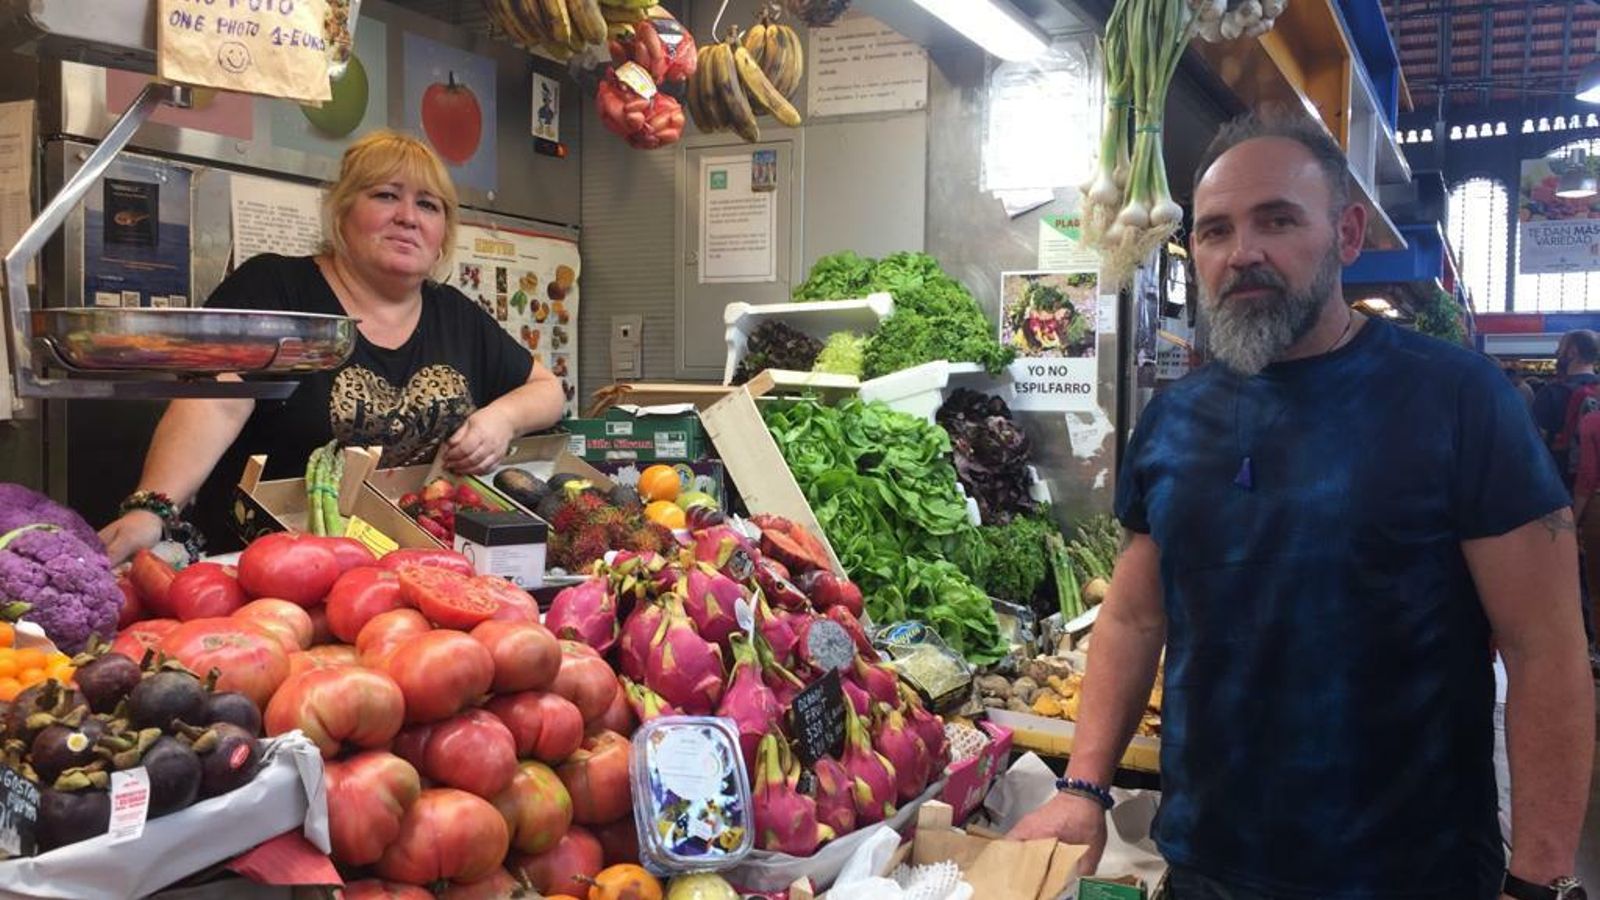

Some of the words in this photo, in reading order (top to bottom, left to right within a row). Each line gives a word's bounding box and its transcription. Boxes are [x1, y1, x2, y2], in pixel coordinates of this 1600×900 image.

[169, 10, 205, 32] ONE
[217, 18, 260, 37] PHOTO
[1528, 228, 1542, 239] TE
[1543, 226, 1571, 238] DAN
[1536, 234, 1593, 247] VARIEDAD
[1028, 365, 1045, 377] YO
[1048, 365, 1068, 377] NO
